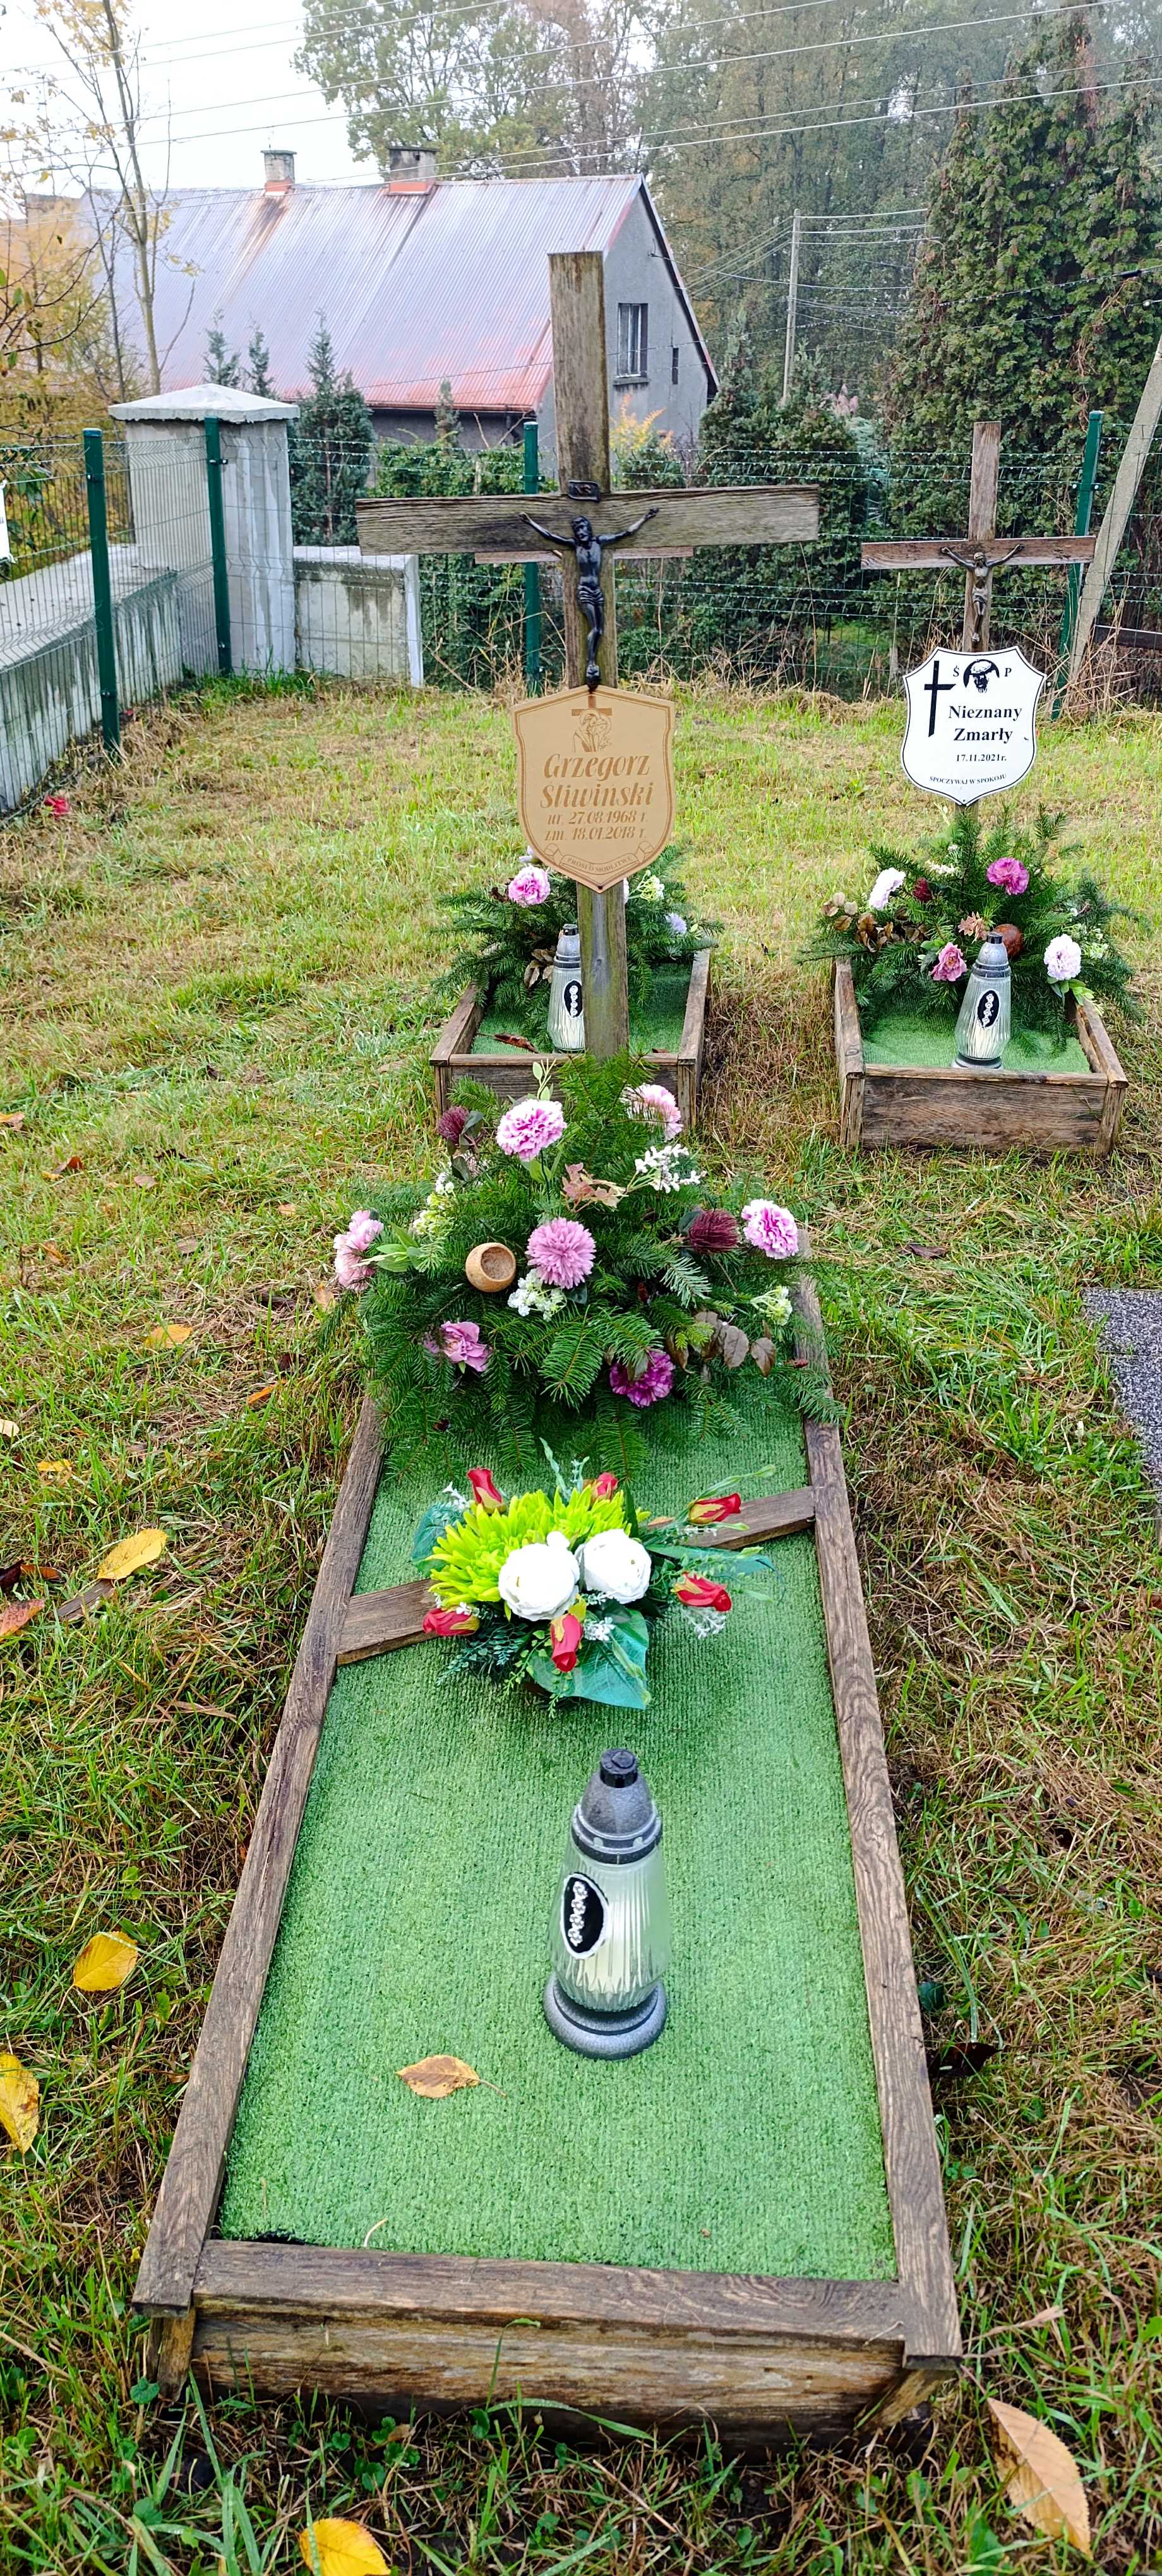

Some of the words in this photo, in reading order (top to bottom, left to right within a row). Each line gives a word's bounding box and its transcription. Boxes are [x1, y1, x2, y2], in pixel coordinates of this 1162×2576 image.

[952, 665, 960, 677] Ś
[1004, 667, 1012, 677] P
[949, 705, 1022, 721] Nieznany
[953, 728, 1013, 744] Zmarły
[544, 753, 650, 781] Grzegorz
[930, 776, 967, 784] SPOCZYWAJ
[977, 773, 1007, 783] SPOKOJU
[540, 781, 654, 809] Śliwiński
[548, 814, 564, 825] ur.
[569, 810, 637, 825] 27.08.1968
[544, 830, 566, 841] zm.
[572, 826, 636, 840] 18.01.2018
[639, 828, 647, 838] r.
